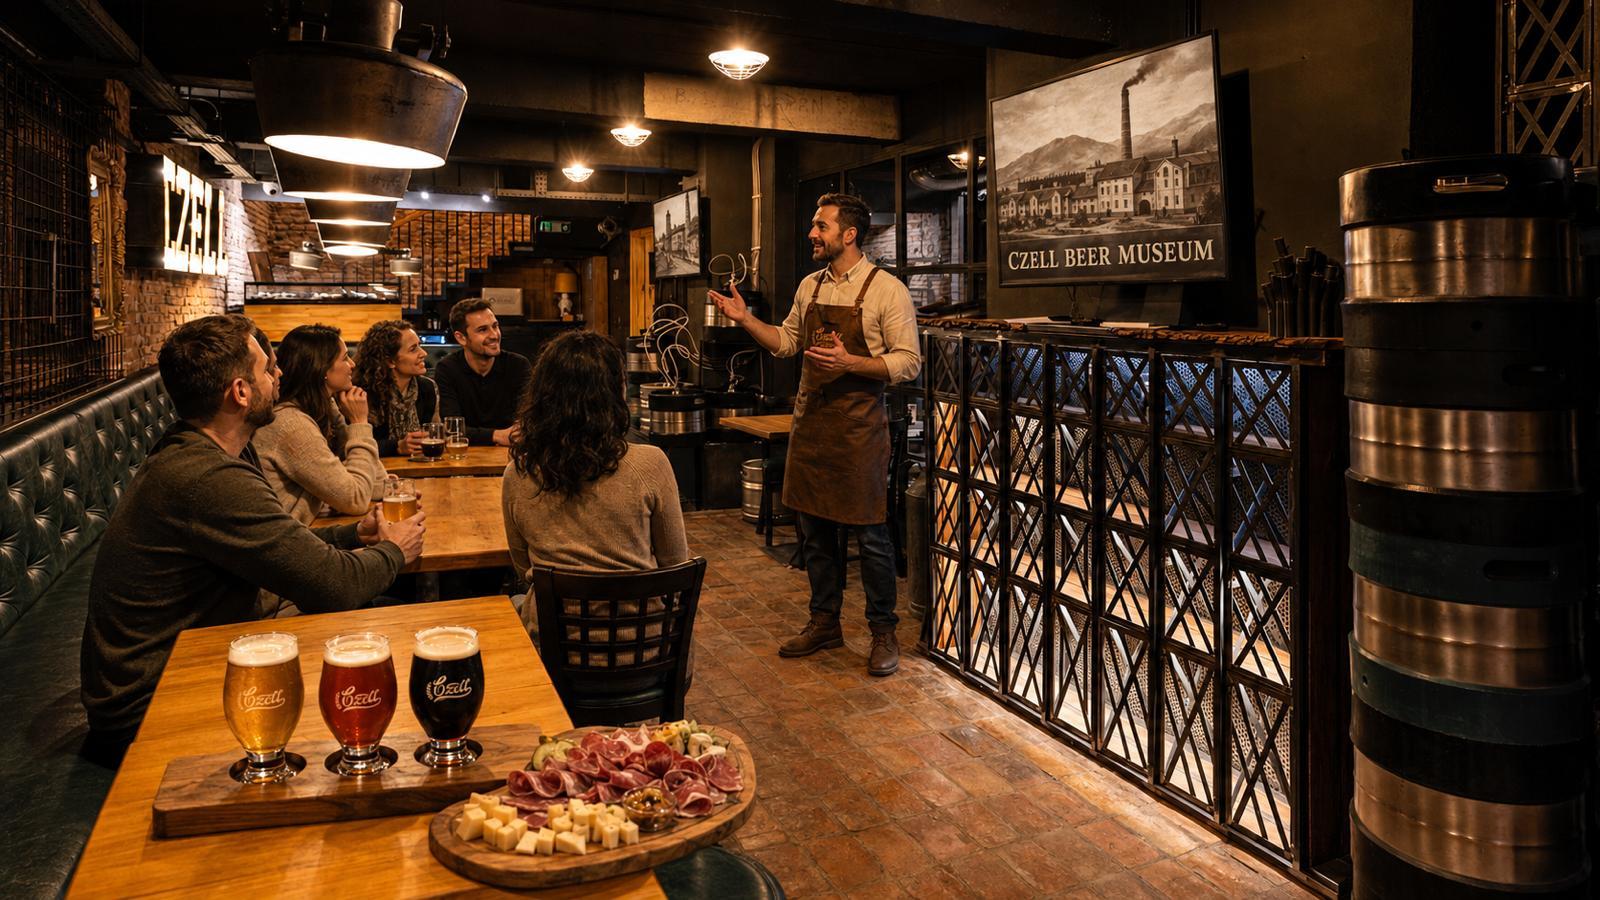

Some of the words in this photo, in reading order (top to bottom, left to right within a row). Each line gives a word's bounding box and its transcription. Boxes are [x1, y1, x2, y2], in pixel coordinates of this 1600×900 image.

[163, 154, 228, 276] CZELL
[1008, 251, 1059, 270] CZELL
[1065, 246, 1111, 267] BEER
[1118, 239, 1214, 264] MUSEUM
[242, 686, 286, 712] Czell
[341, 685, 381, 712] Czell
[432, 675, 472, 702] Czell
